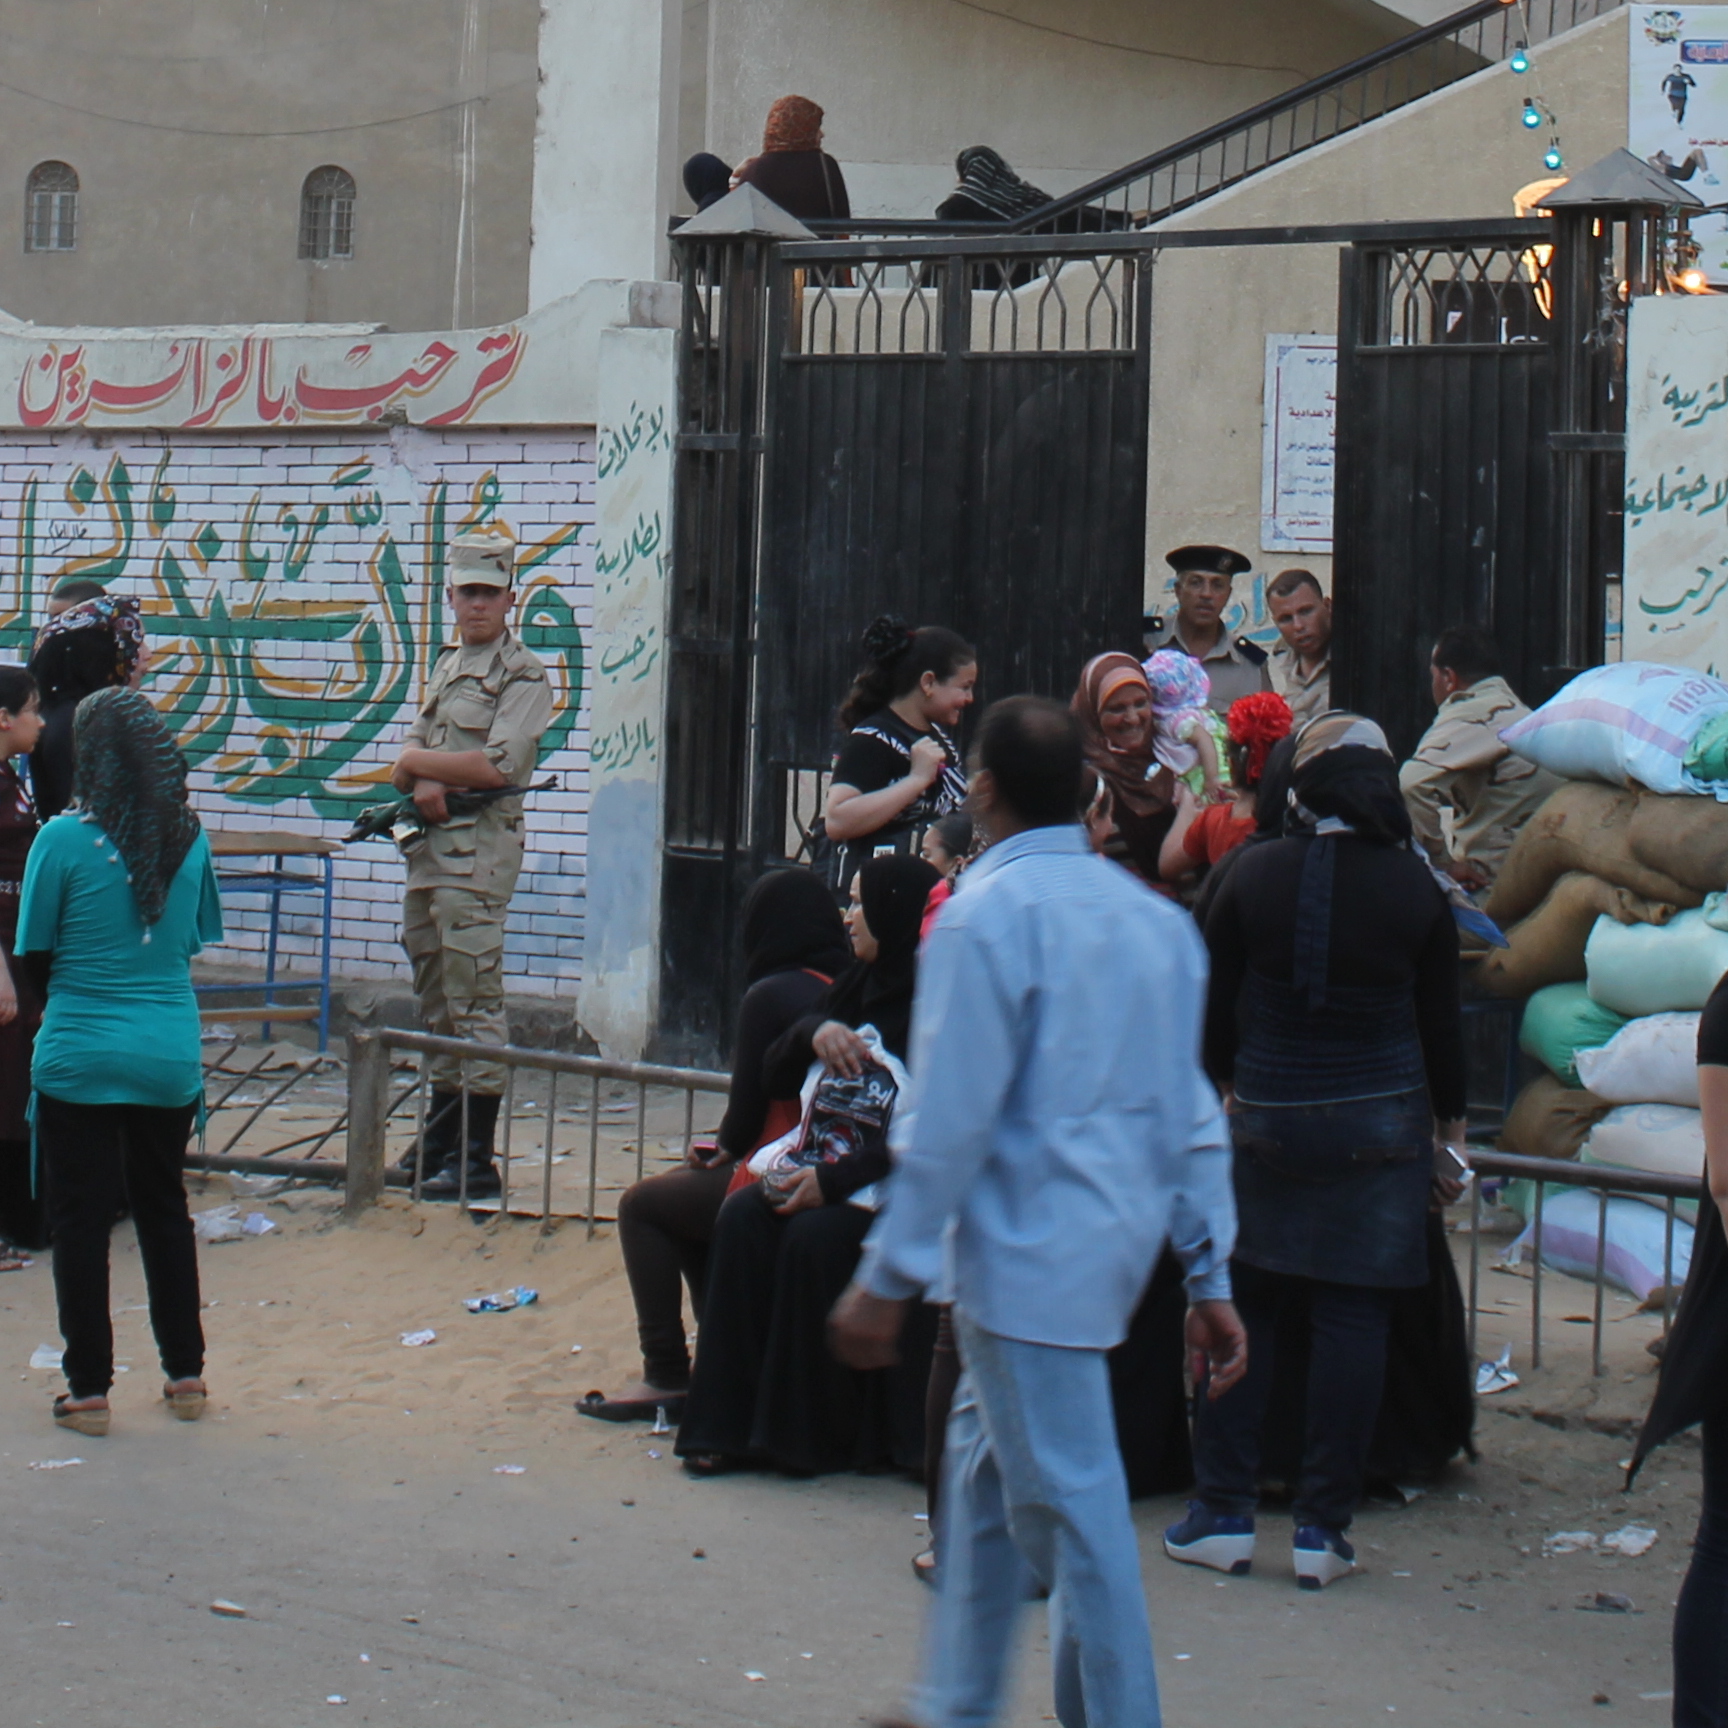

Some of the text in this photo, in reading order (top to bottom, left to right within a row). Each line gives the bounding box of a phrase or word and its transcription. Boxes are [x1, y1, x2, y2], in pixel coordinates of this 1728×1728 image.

[18, 330, 524, 427] ترحب بالزائرين
[599, 624, 660, 684] ترحب
